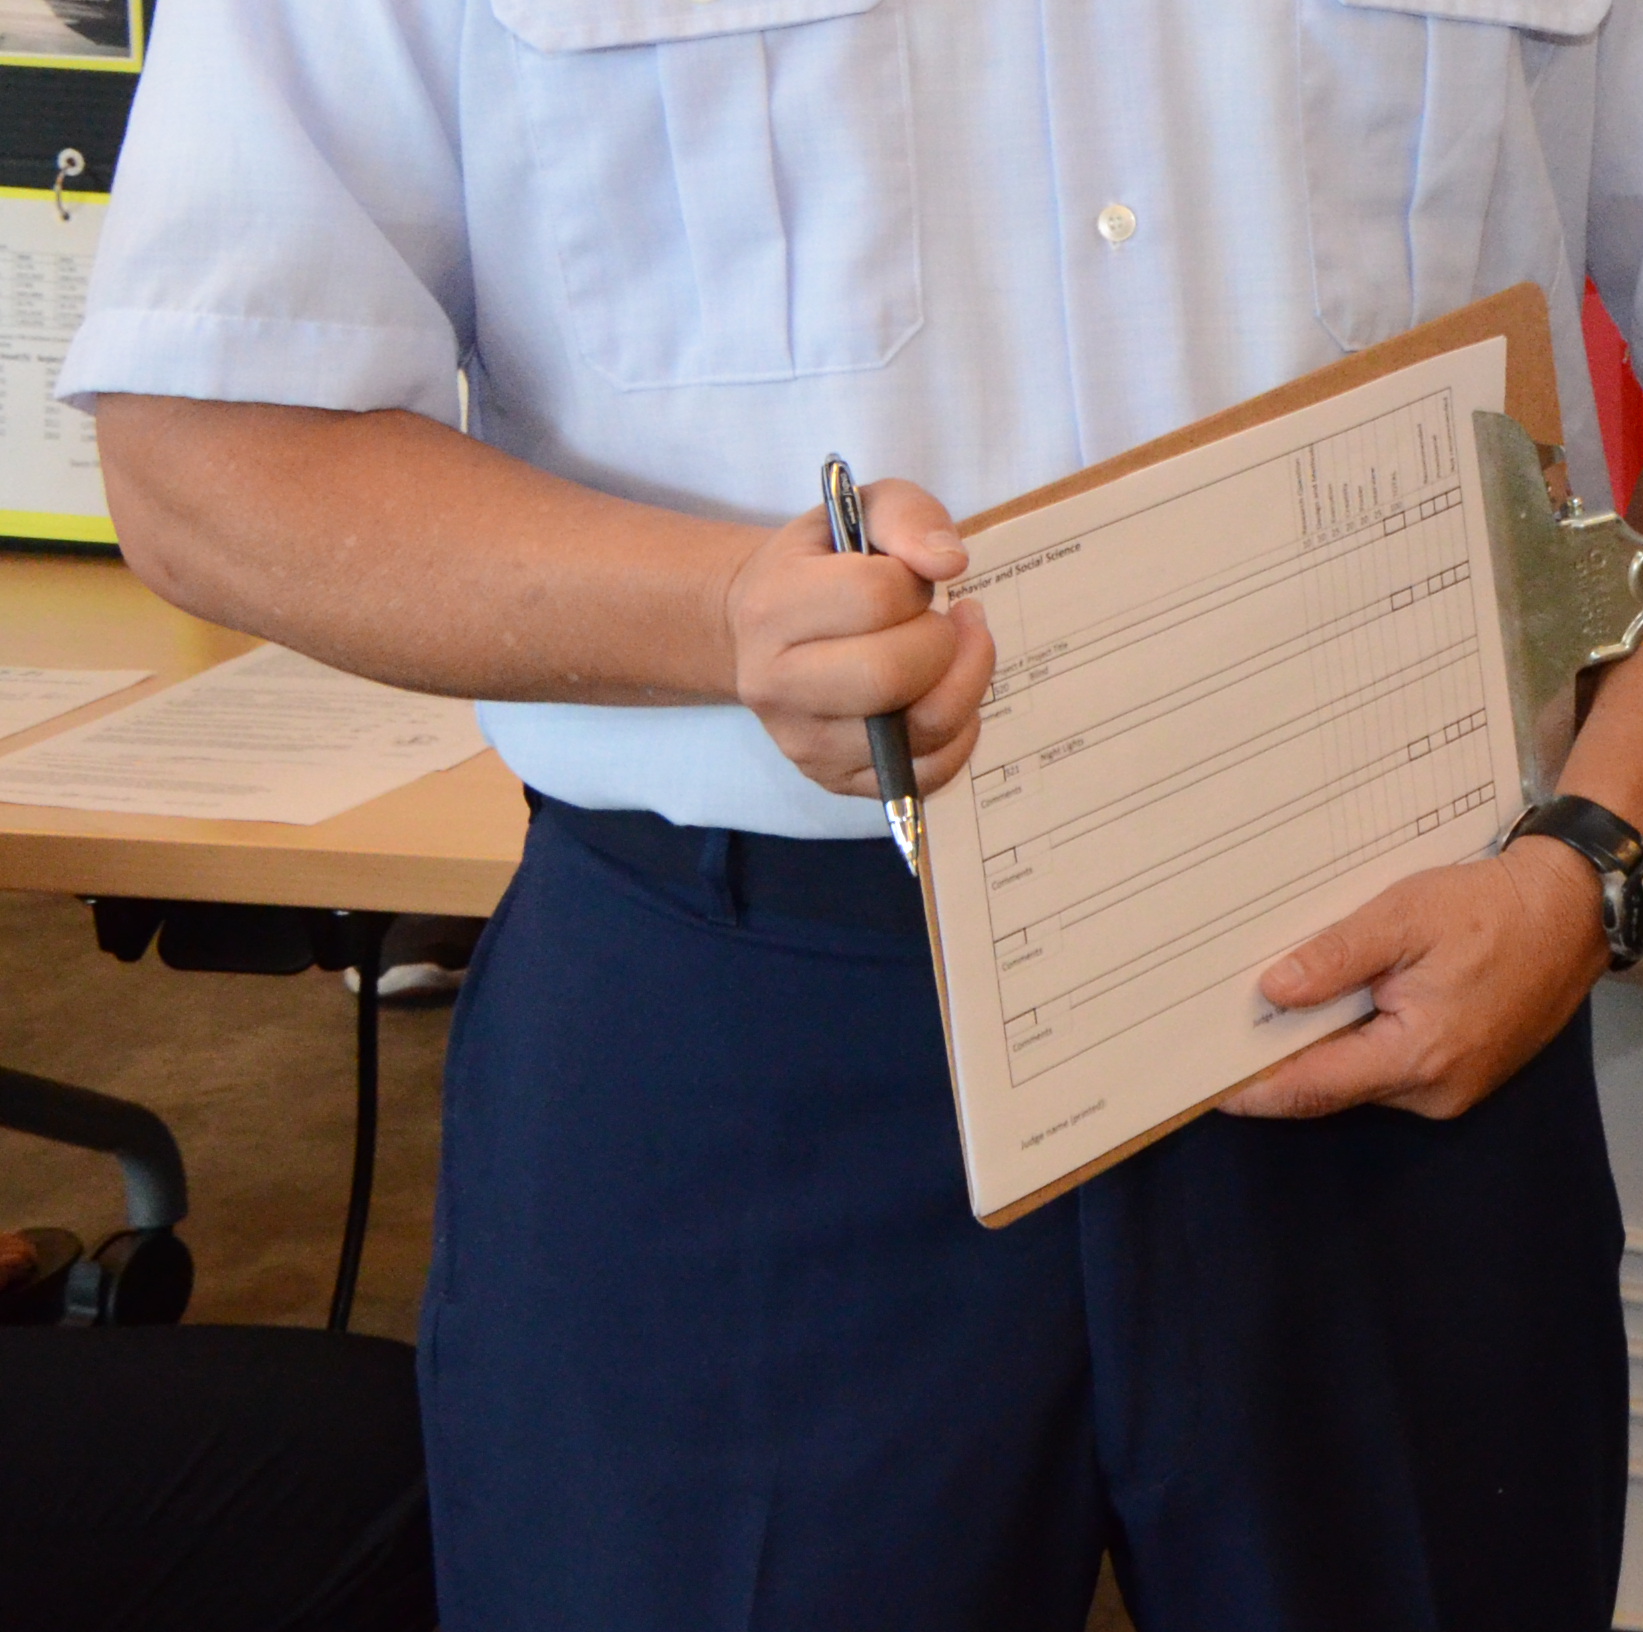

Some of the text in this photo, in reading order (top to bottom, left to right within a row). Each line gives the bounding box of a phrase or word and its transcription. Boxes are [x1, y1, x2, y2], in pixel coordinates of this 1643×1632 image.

[948, 542, 1081, 602] Behavior and Social Science
[980, 785, 1022, 810] Comments
[991, 866, 1033, 892] Comments
[1001, 947, 1043, 972] Comments
[1012, 1027, 1053, 1052] Comments
[1021, 1117, 1069, 1151] Judge name
